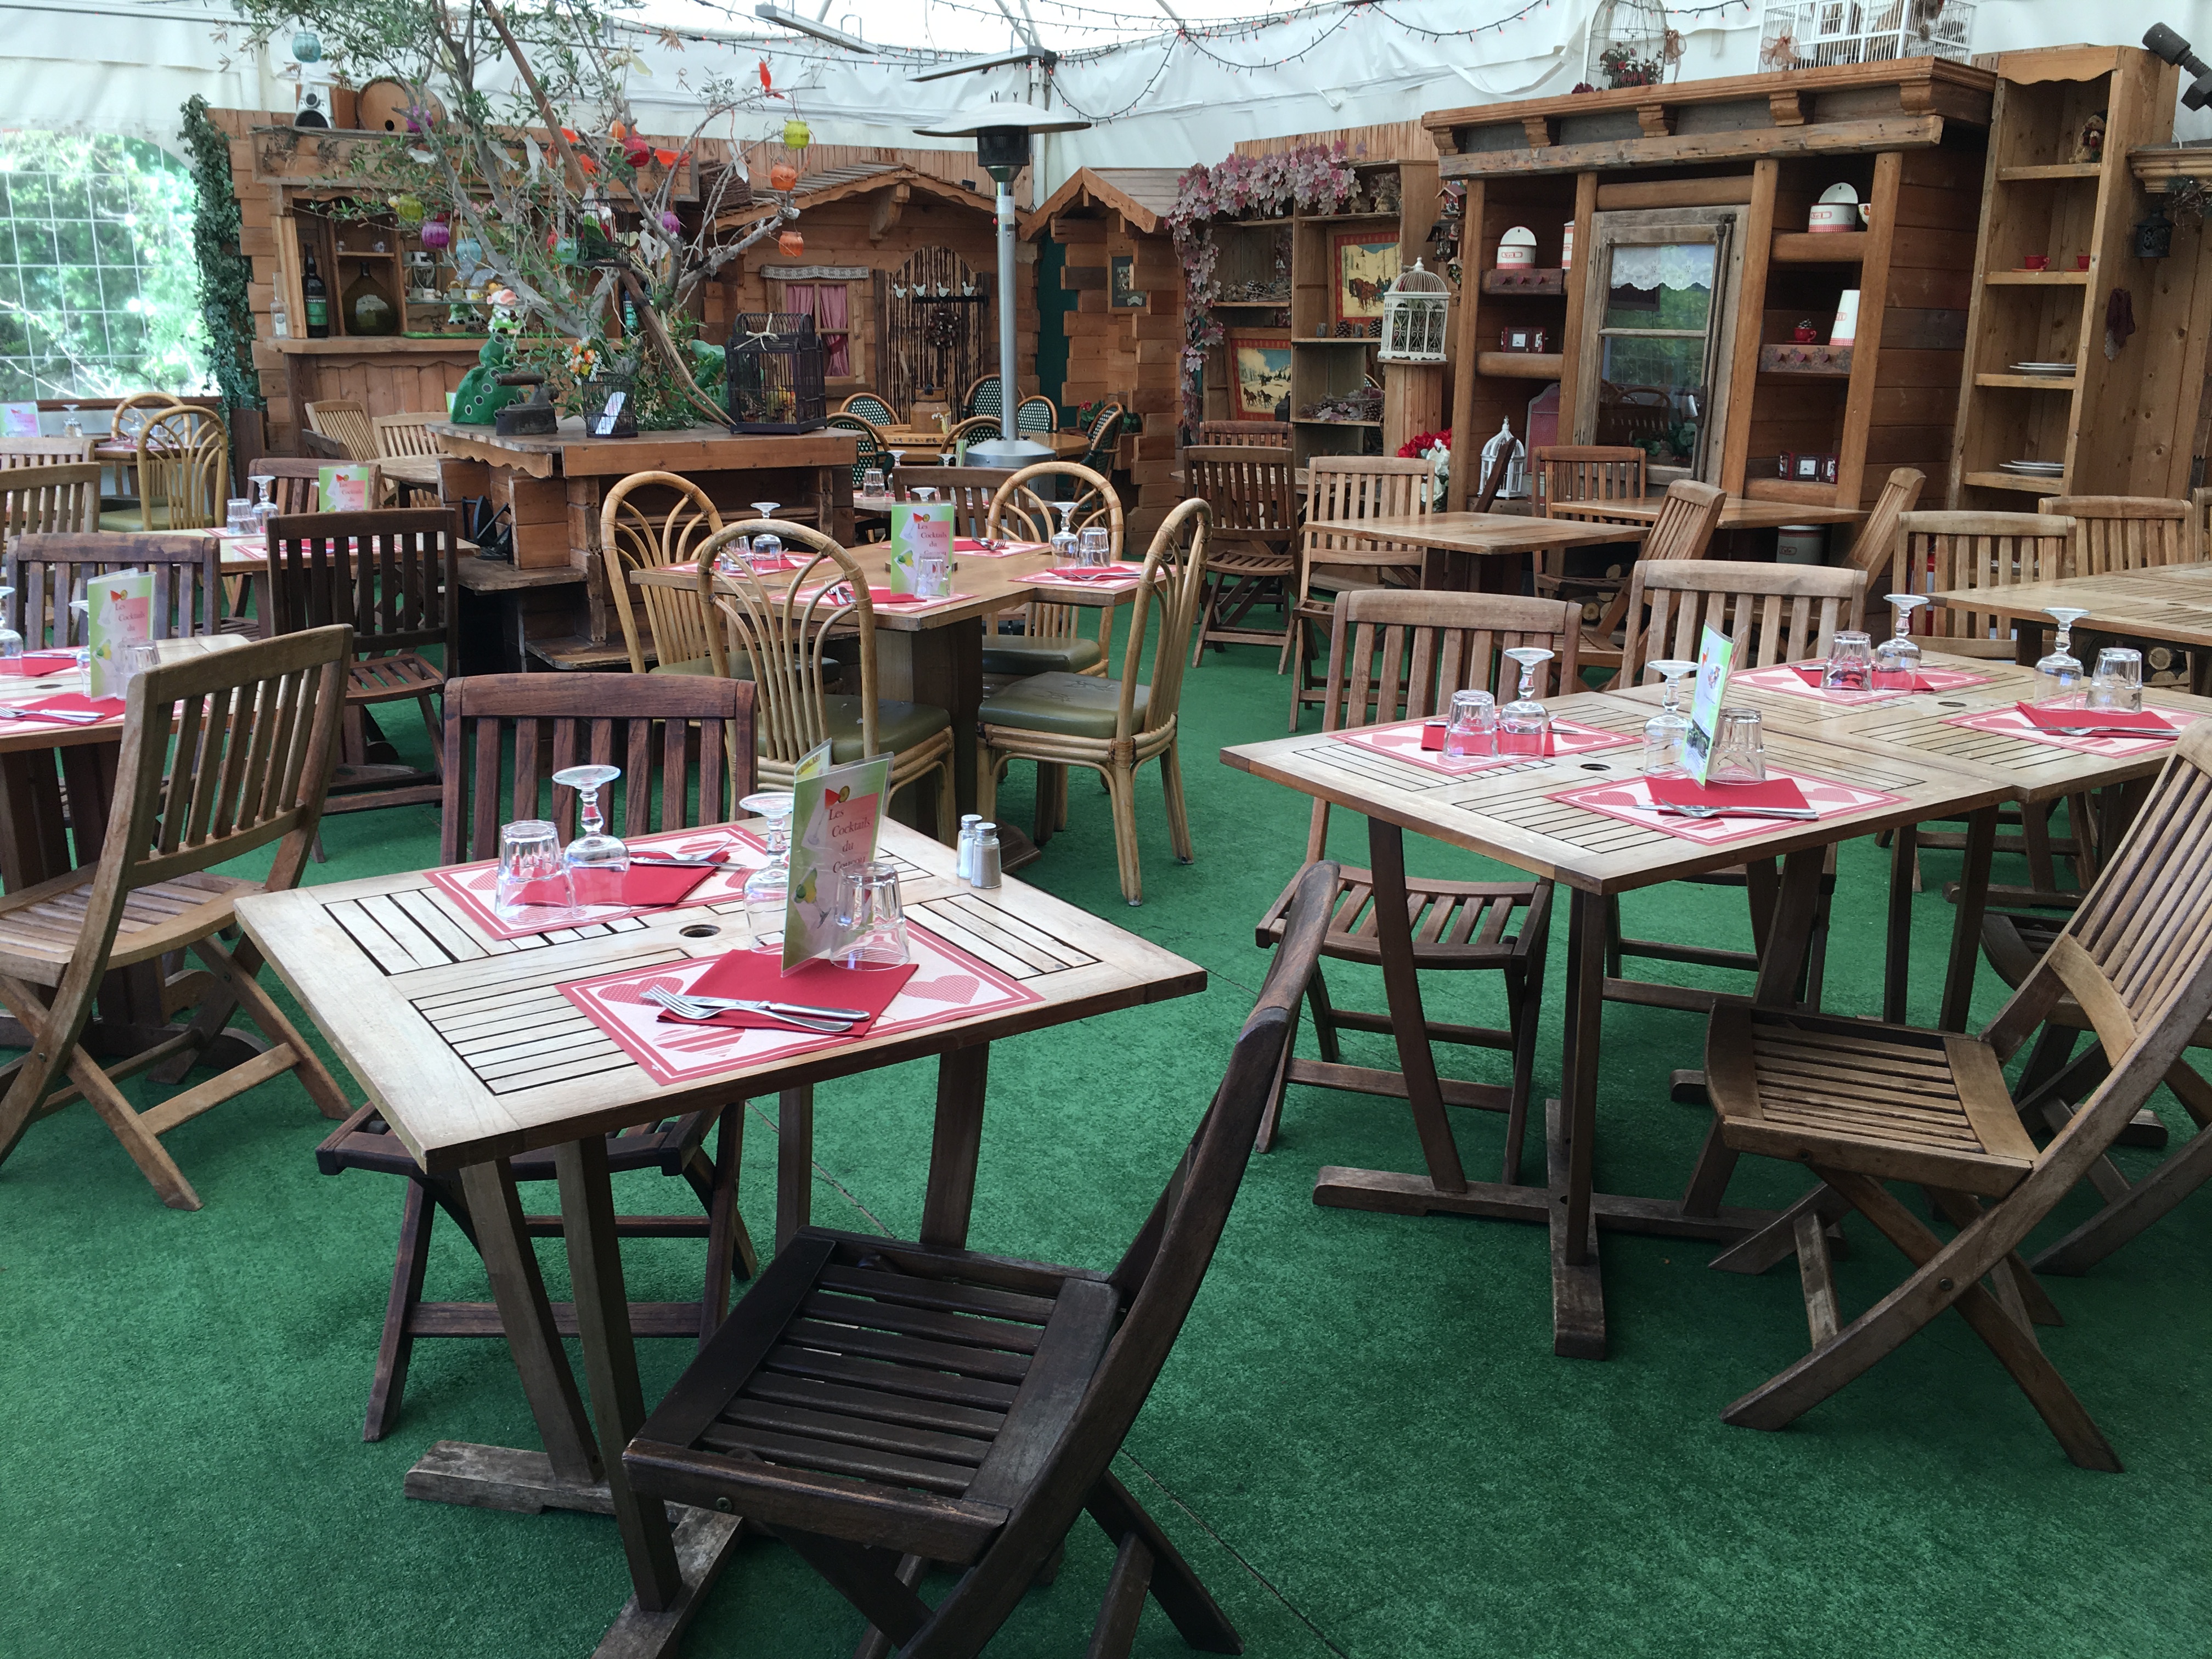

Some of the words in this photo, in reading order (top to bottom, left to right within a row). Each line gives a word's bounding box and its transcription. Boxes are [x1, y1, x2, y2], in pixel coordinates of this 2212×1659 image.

[118, 611, 146, 622] Cocktails
[828, 809, 844, 821] Les
[831, 816, 871, 838] Cocktails
[842, 840, 854, 852] du
